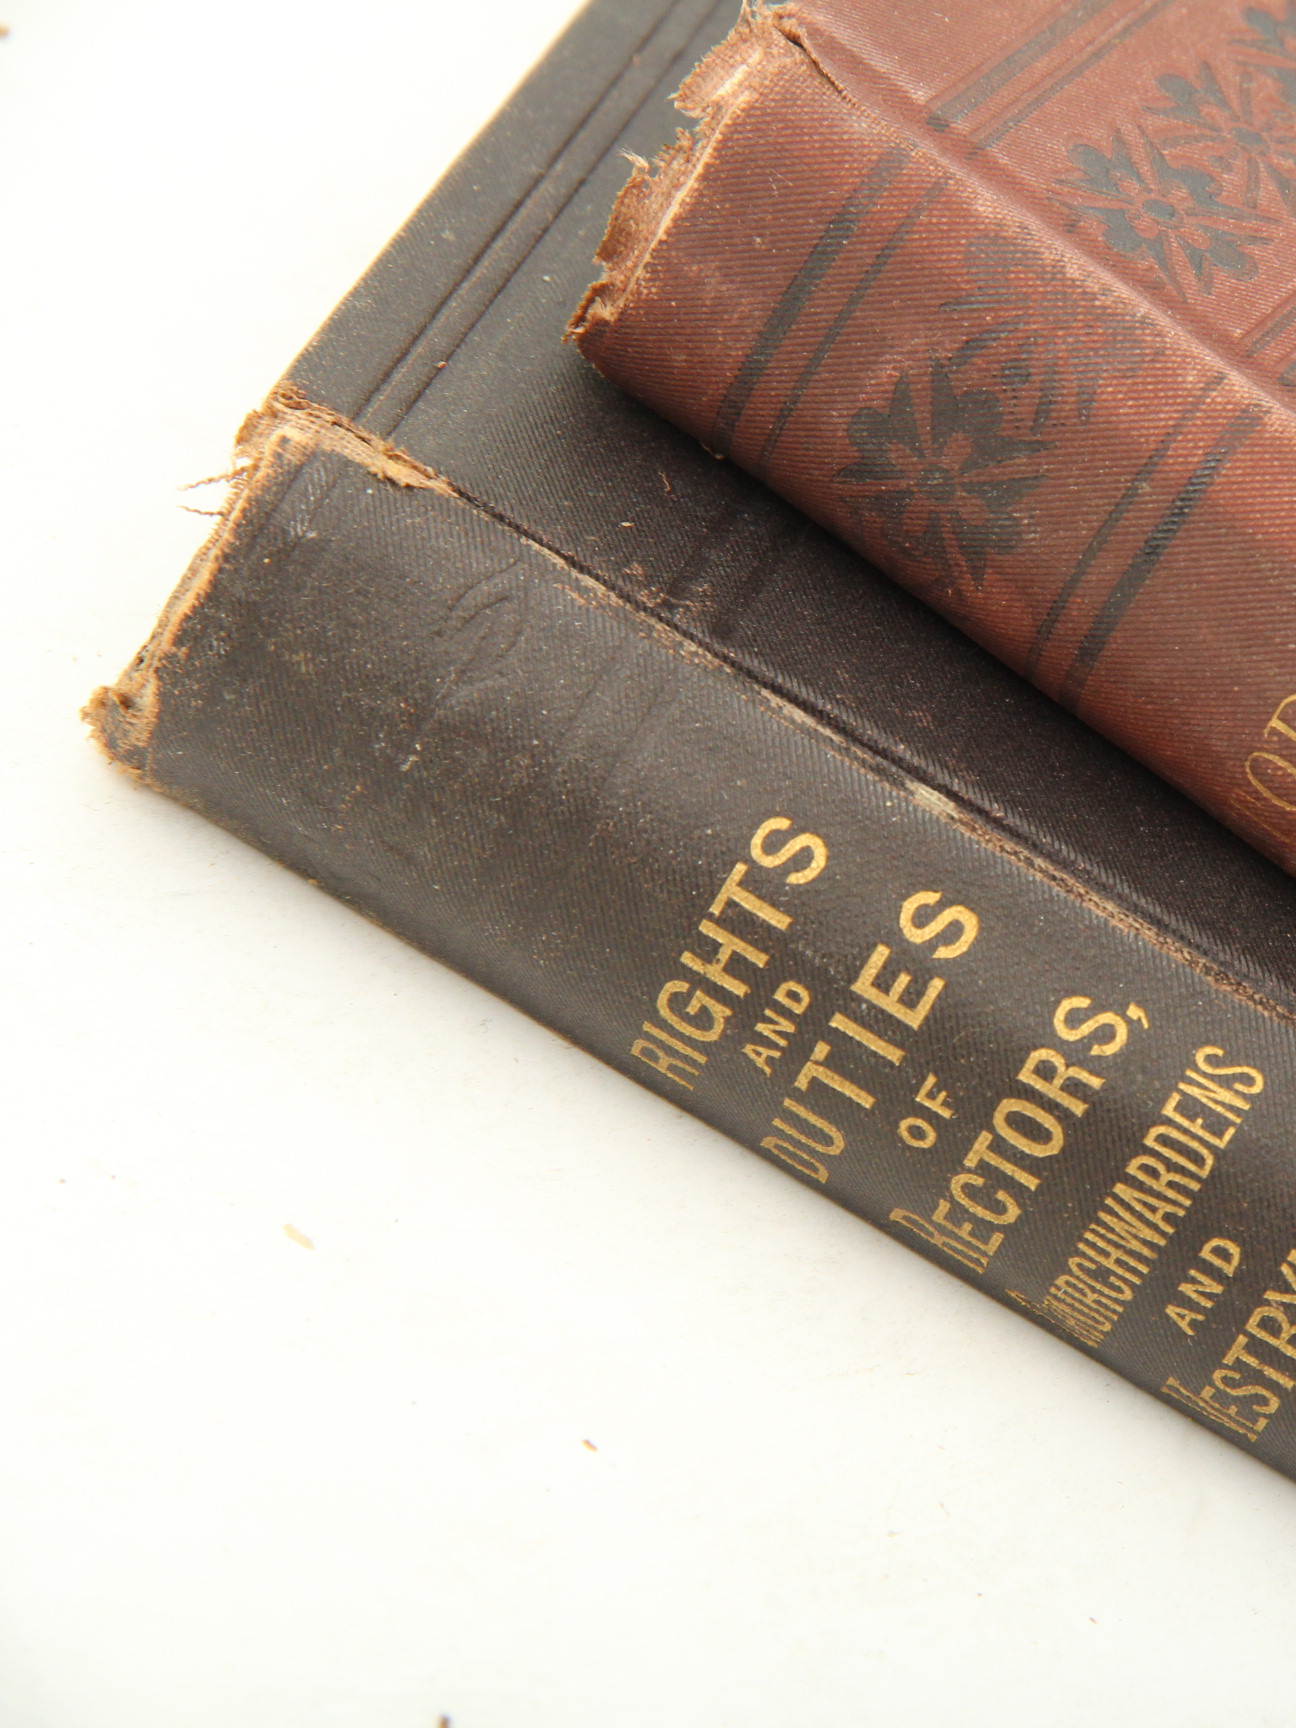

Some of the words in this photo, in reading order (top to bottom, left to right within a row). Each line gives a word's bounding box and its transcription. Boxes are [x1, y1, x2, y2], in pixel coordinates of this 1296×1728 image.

[630, 817, 828, 1090] RIGHTS
[742, 981, 811, 1076] AND
[760, 891, 980, 1184] DUTIES
[890, 996, 1149, 1273] RECTORS,
[897, 1073, 955, 1149] OF
[1165, 1237, 1241, 1335] AND
